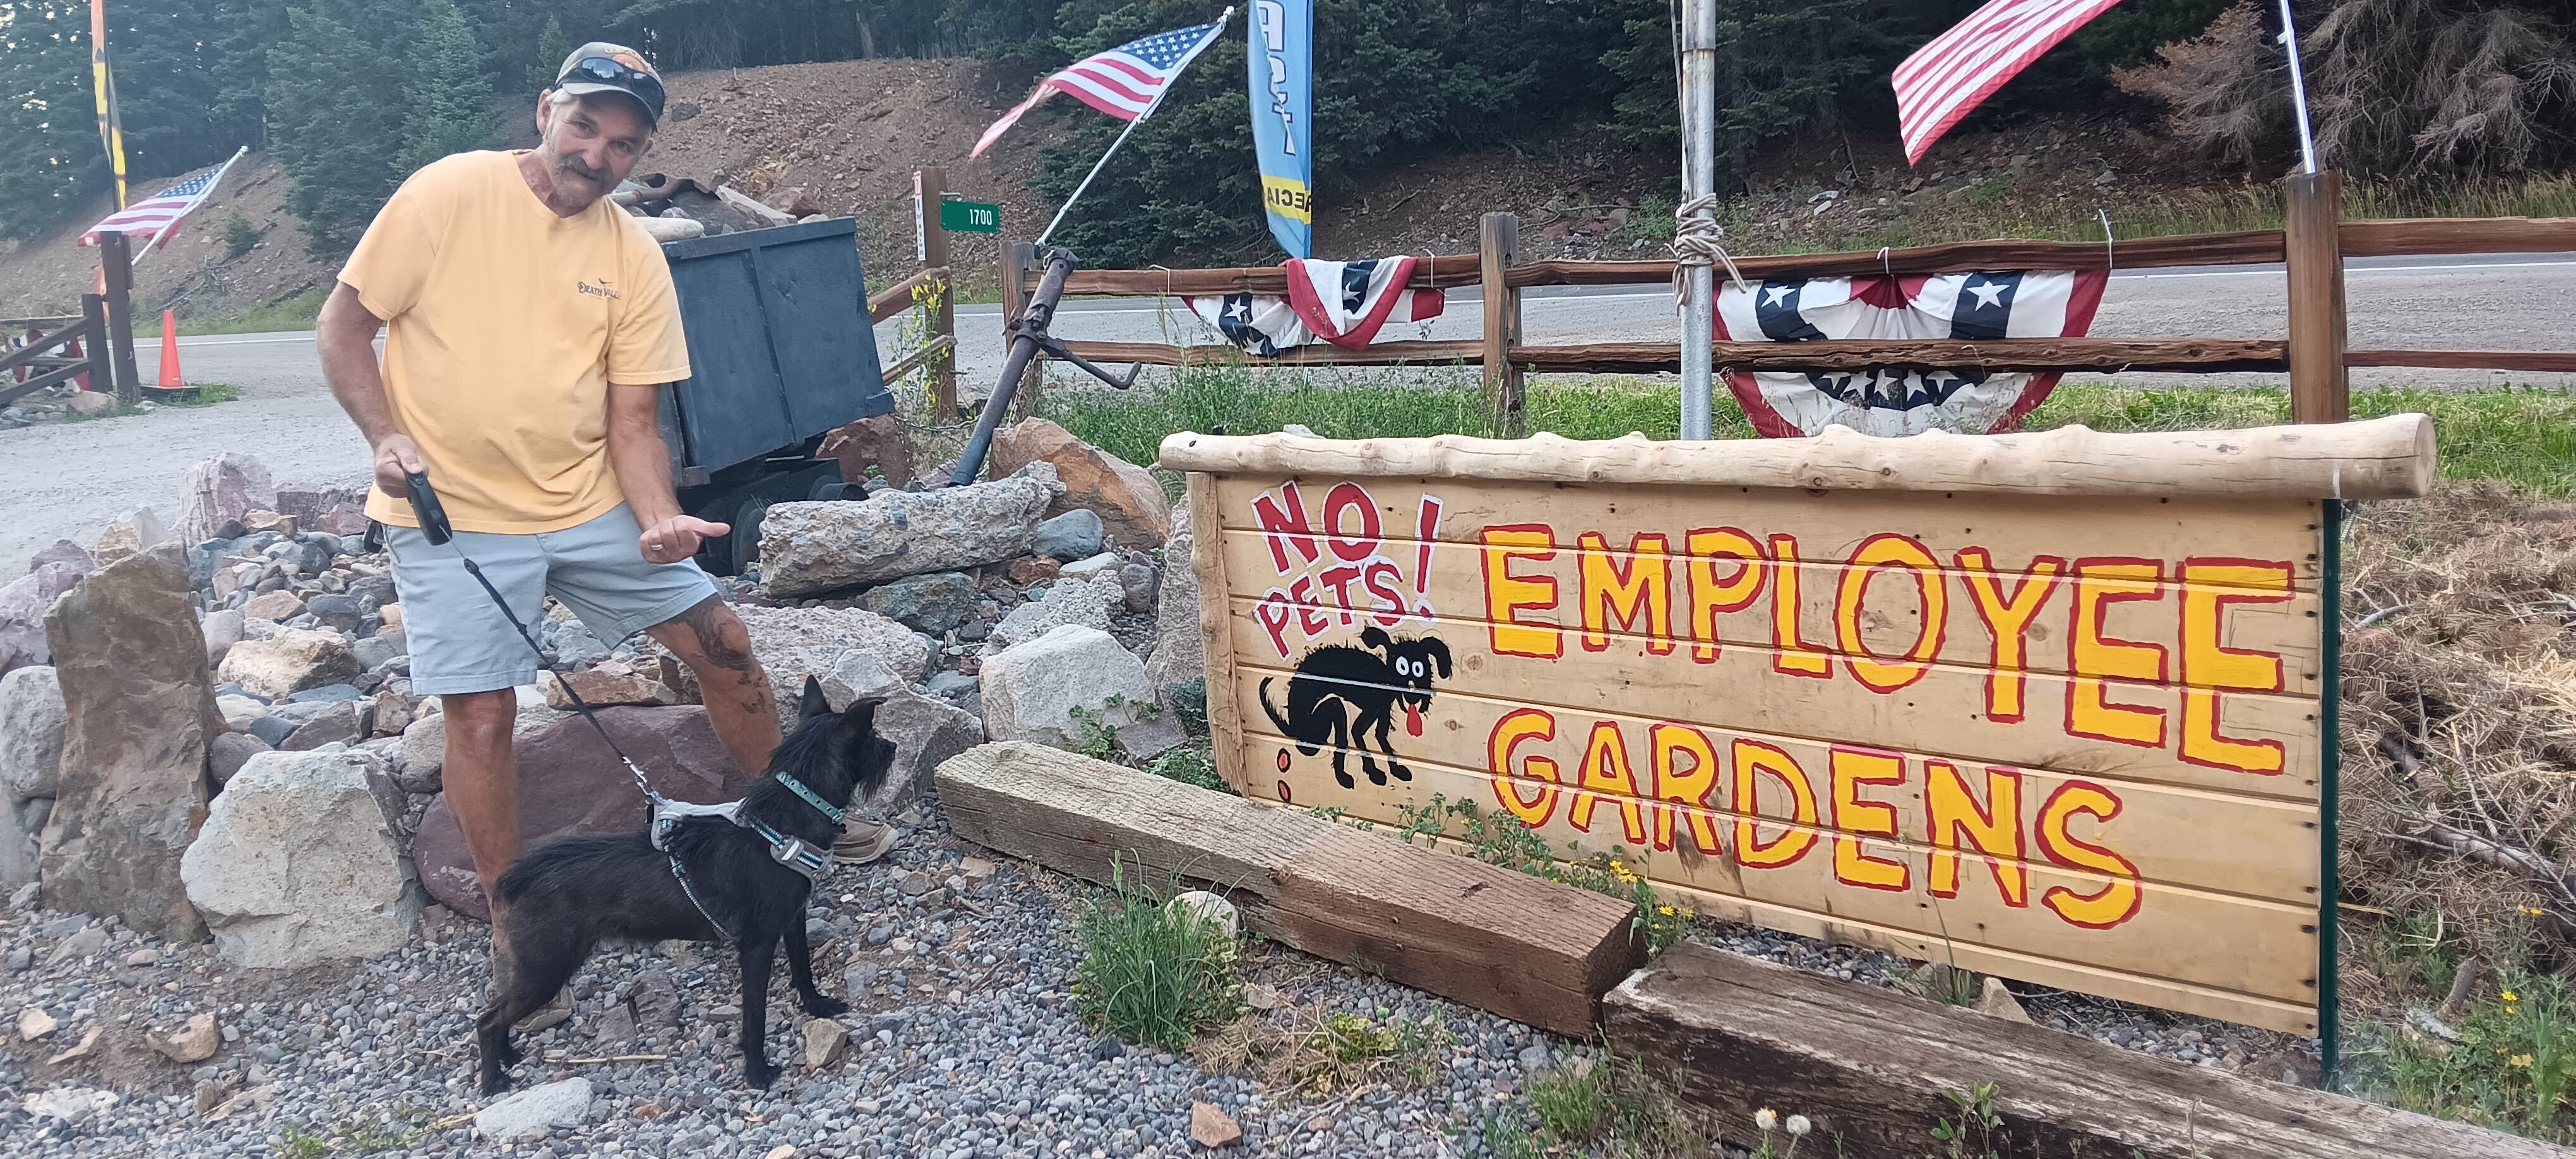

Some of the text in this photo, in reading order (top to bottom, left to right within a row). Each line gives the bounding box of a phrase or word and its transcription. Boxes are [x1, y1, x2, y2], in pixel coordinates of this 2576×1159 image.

[969, 208, 993, 225] 1700
[1479, 524, 2295, 776] EMPLOYEE
[1487, 707, 2142, 929] GARDENS
